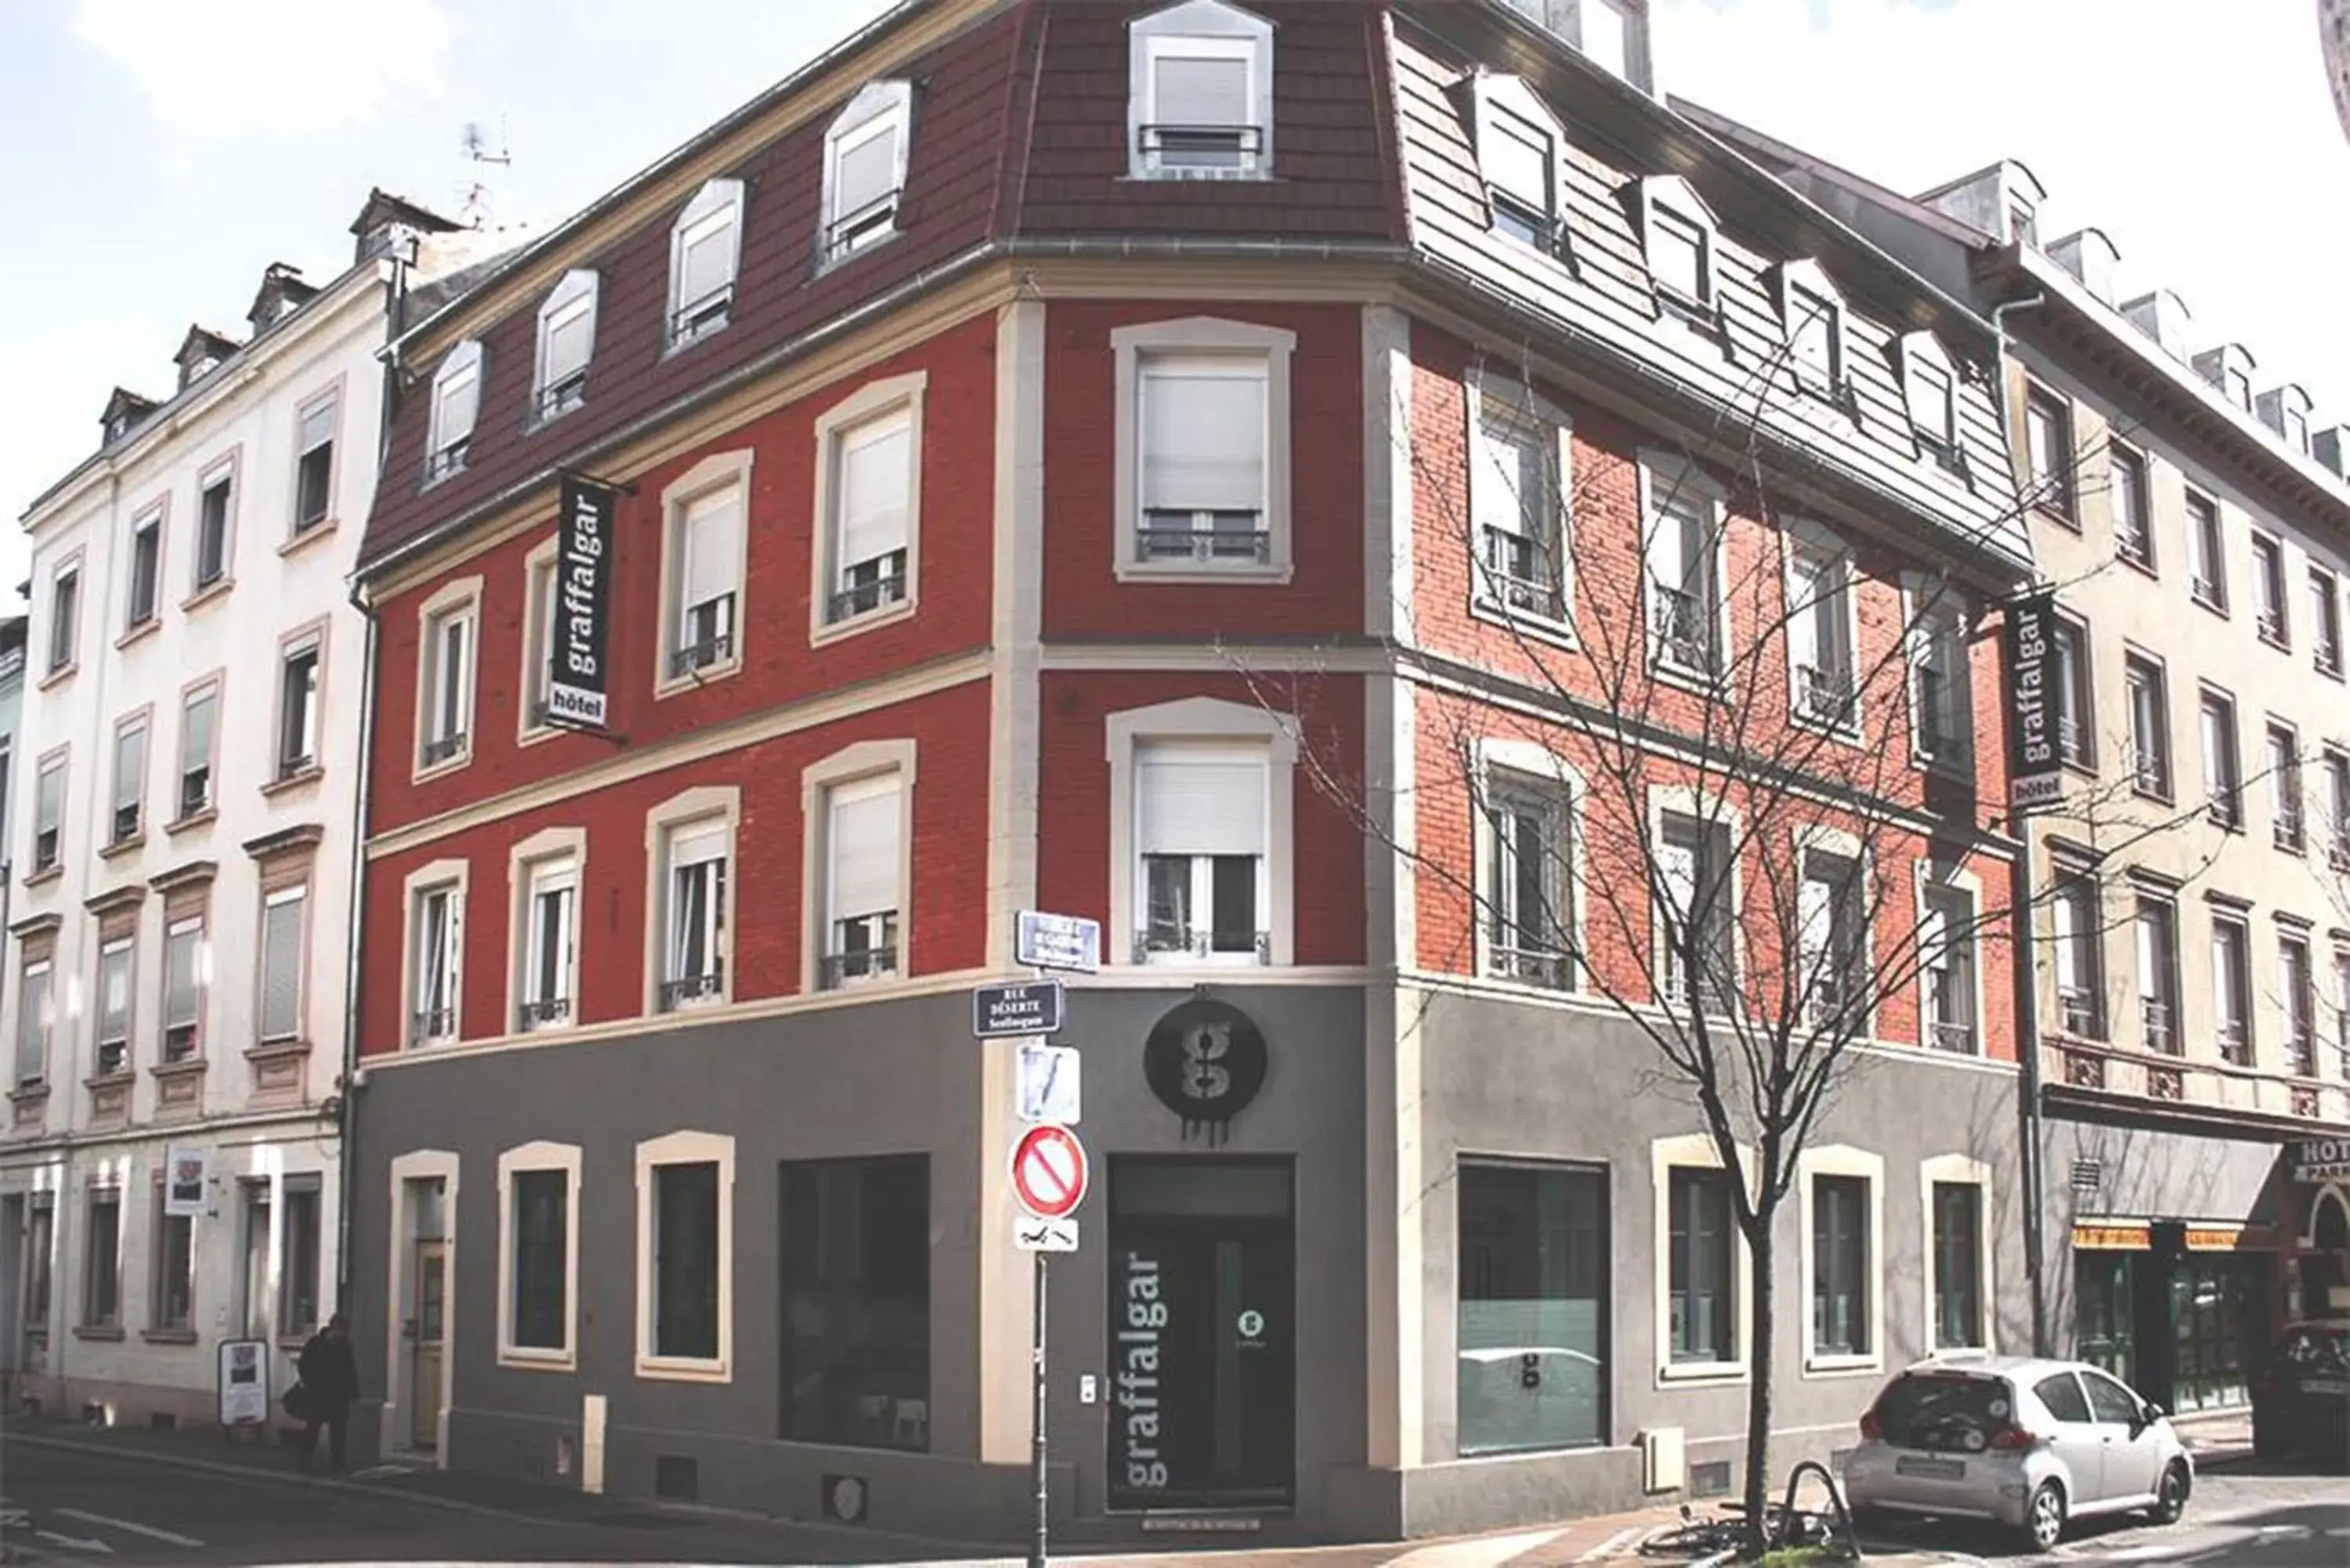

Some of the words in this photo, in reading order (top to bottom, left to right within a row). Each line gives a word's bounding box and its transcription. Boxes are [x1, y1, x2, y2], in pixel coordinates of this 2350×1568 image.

[564, 494, 602, 676] graffalgar
[553, 690, 601, 718] hôtel
[2015, 610, 2051, 762] graffalgar
[2015, 779, 2059, 800] hôtel
[1181, 1020, 1233, 1100] g
[2302, 1141, 2350, 1162] HOT
[1118, 1251, 1168, 1487] graffalgar
